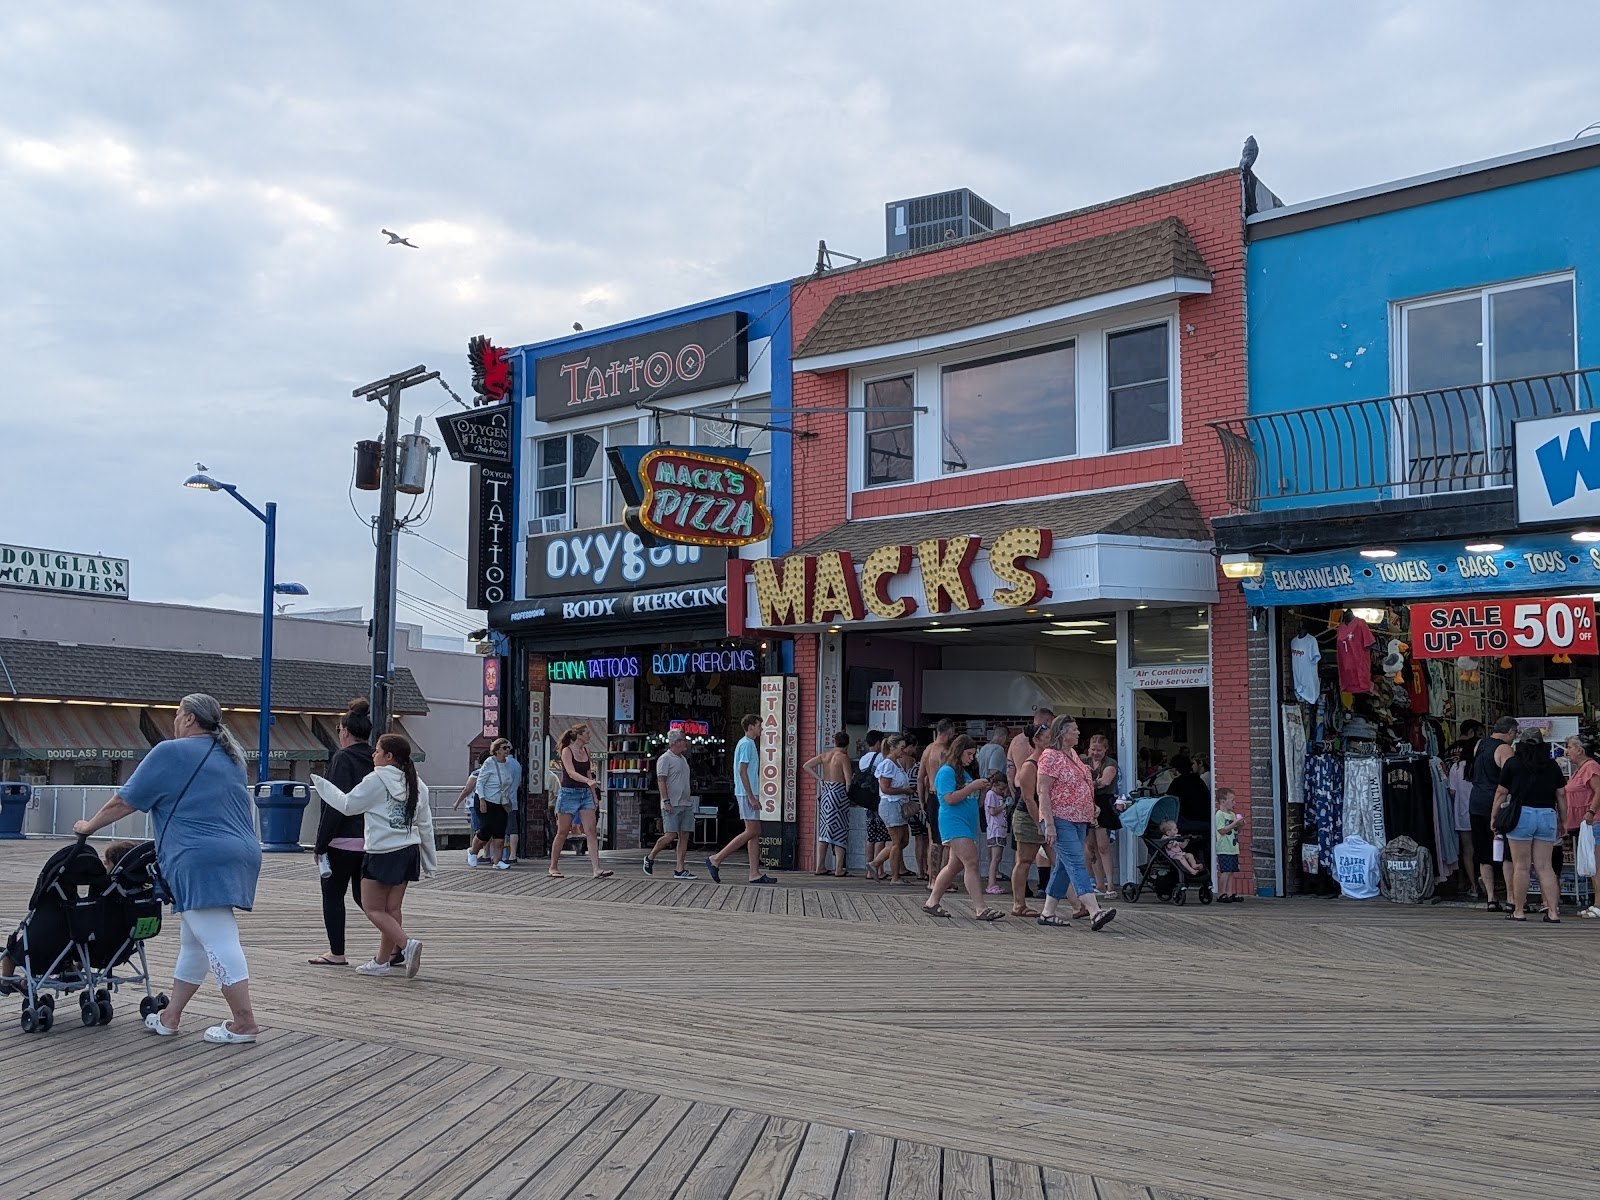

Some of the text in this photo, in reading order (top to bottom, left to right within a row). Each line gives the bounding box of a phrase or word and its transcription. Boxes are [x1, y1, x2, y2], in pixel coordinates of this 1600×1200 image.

[457, 420, 508, 438] OXYGEN
[469, 434, 508, 448] TATTOO
[482, 468, 512, 479] OXYGEN
[655, 461, 744, 495] MACK'S
[653, 488, 754, 536] PIZZA
[485, 479, 505, 603] TATTOO
[2, 548, 124, 577] DOUGLASS
[1271, 564, 1354, 591] BEACHWEAR
[1375, 559, 1432, 583] TOWELS
[1456, 554, 1499, 578] BAGS
[1523, 550, 1567, 574] TOYS
[13, 567, 113, 592] CANDIES
[752, 526, 1050, 626] MACKS
[510, 607, 546, 622] PROFESSIONAL
[562, 597, 619, 620] BODY
[1430, 605, 1502, 629] SALE
[1424, 629, 1508, 652] UP TO
[1579, 632, 1592, 641] OFF
[548, 656, 639, 680] HENNA TATTOOS
[652, 650, 755, 674] BODY PIERCING
[1151, 667, 1204, 677] Conditioned
[762, 684, 781, 692] REAL
[876, 685, 894, 696] PAY
[872, 700, 897, 711] HERE
[48, 749, 134, 758] DOUGLASS FUDGE
[268, 750, 288, 758] AFFY
[532, 702, 540, 785] BRAIDS
[763, 697, 778, 813] TATTOOS
[786, 681, 797, 821] BODY PIERCING
[1370, 777, 1384, 831] WILDWOOD
[1340, 856, 1366, 866] FAITH
[1340, 865, 1365, 874] OVER
[1387, 860, 1417, 870] PHILLY
[1340, 874, 1366, 885] FEAR
